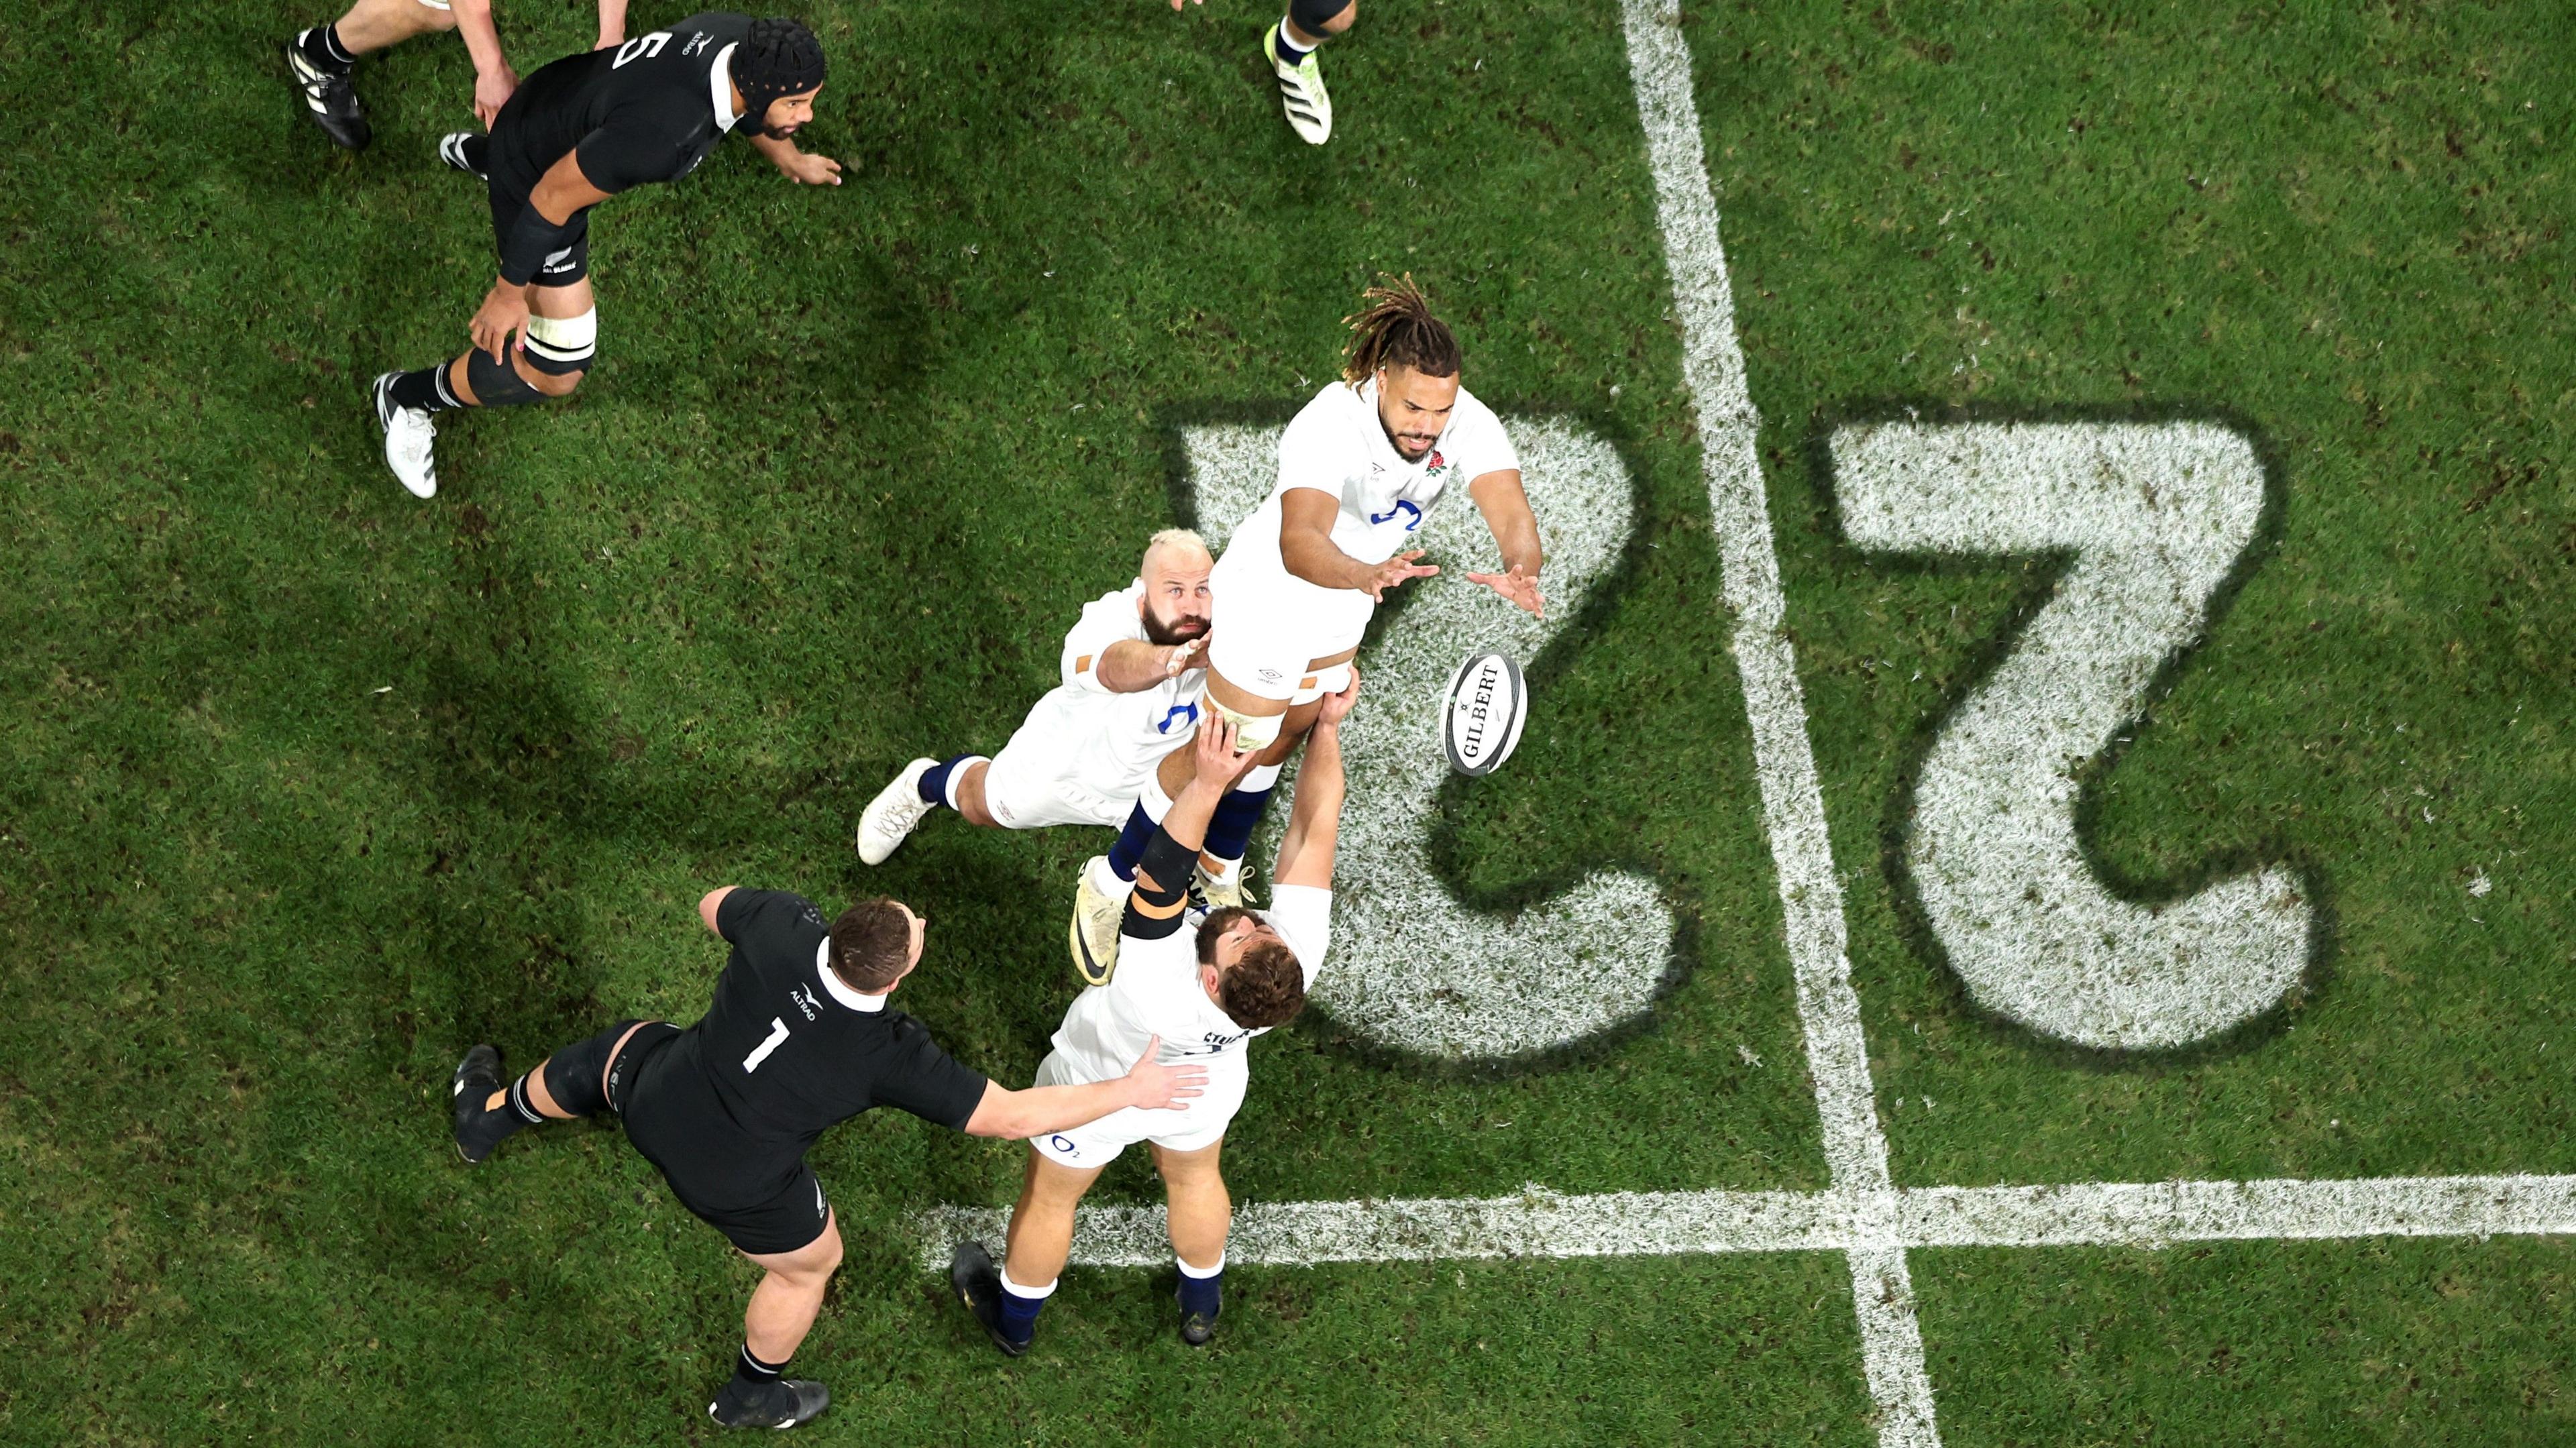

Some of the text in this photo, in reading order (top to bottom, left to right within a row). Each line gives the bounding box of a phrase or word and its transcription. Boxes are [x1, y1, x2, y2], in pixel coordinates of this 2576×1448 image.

[612, 32, 673, 70] 5
[681, 30, 704, 56] ALTRAD
[1463, 664, 1498, 758] GILBERT
[790, 990, 816, 1022] ALTRAD
[743, 1016, 790, 1074] 1
